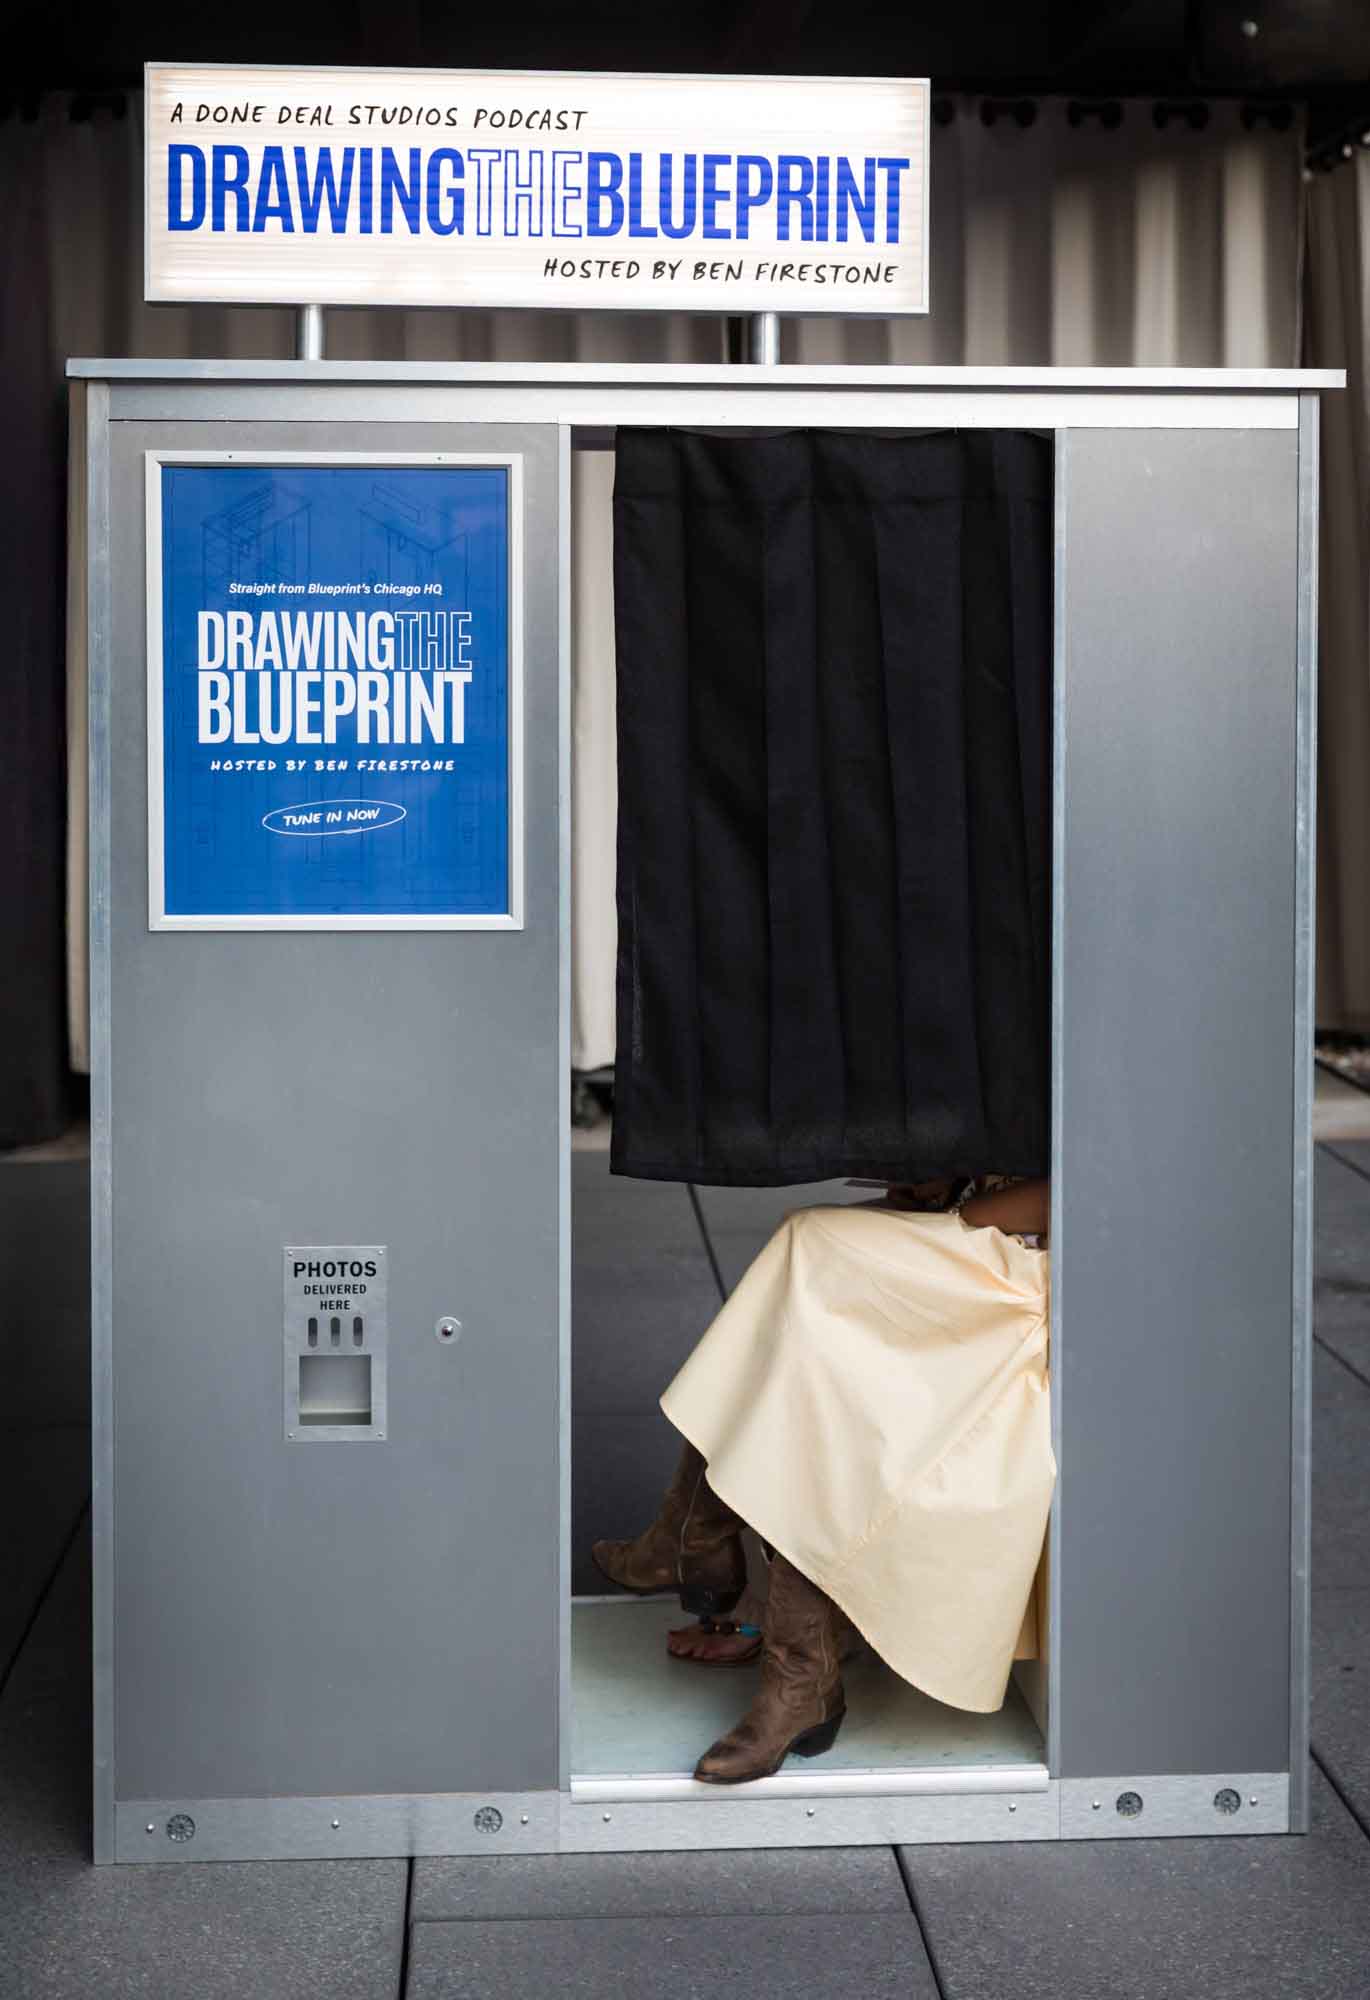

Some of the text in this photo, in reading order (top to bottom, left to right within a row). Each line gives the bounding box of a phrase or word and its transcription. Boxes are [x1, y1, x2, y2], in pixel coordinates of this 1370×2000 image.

[170, 102, 588, 131] A DONE DEAL STUDIOS PODCAST
[543, 258, 899, 284] HOSTED BY BEN FIRESTONE
[229, 583, 443, 596] Straight from Blueprint's Chicago HQ
[198, 670, 473, 745] BLUEPRINT
[210, 759, 455, 772] HOSTED BY BEN FIRESTONE
[282, 807, 381, 828] TUNE IN NOW
[293, 1260, 377, 1278] PHOTOS
[303, 1283, 367, 1296] DELIVERED
[319, 1299, 351, 1311] HERE
